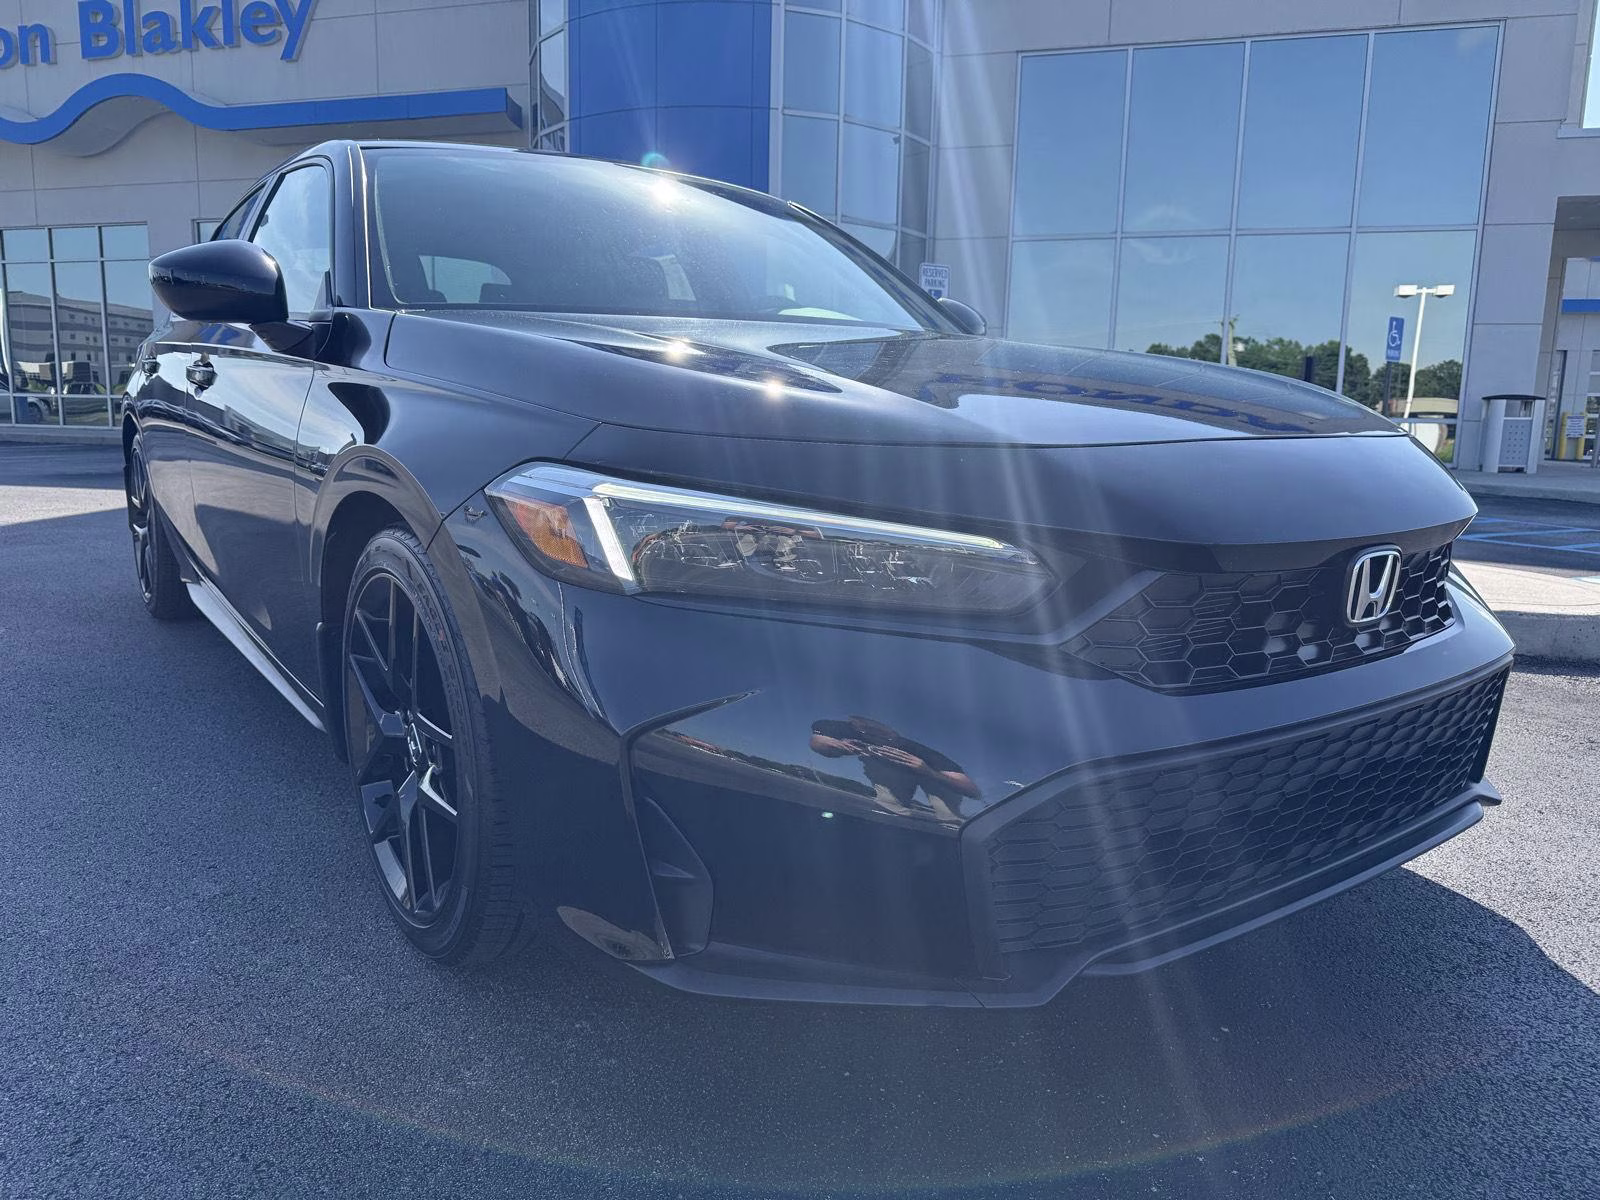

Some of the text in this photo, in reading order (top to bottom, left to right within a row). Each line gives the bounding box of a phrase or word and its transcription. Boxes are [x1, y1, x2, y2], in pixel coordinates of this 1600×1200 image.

[78, 0, 316, 62] Blakley
[922, 267, 948, 279] RESERVED
[924, 278, 946, 289] PARKING
